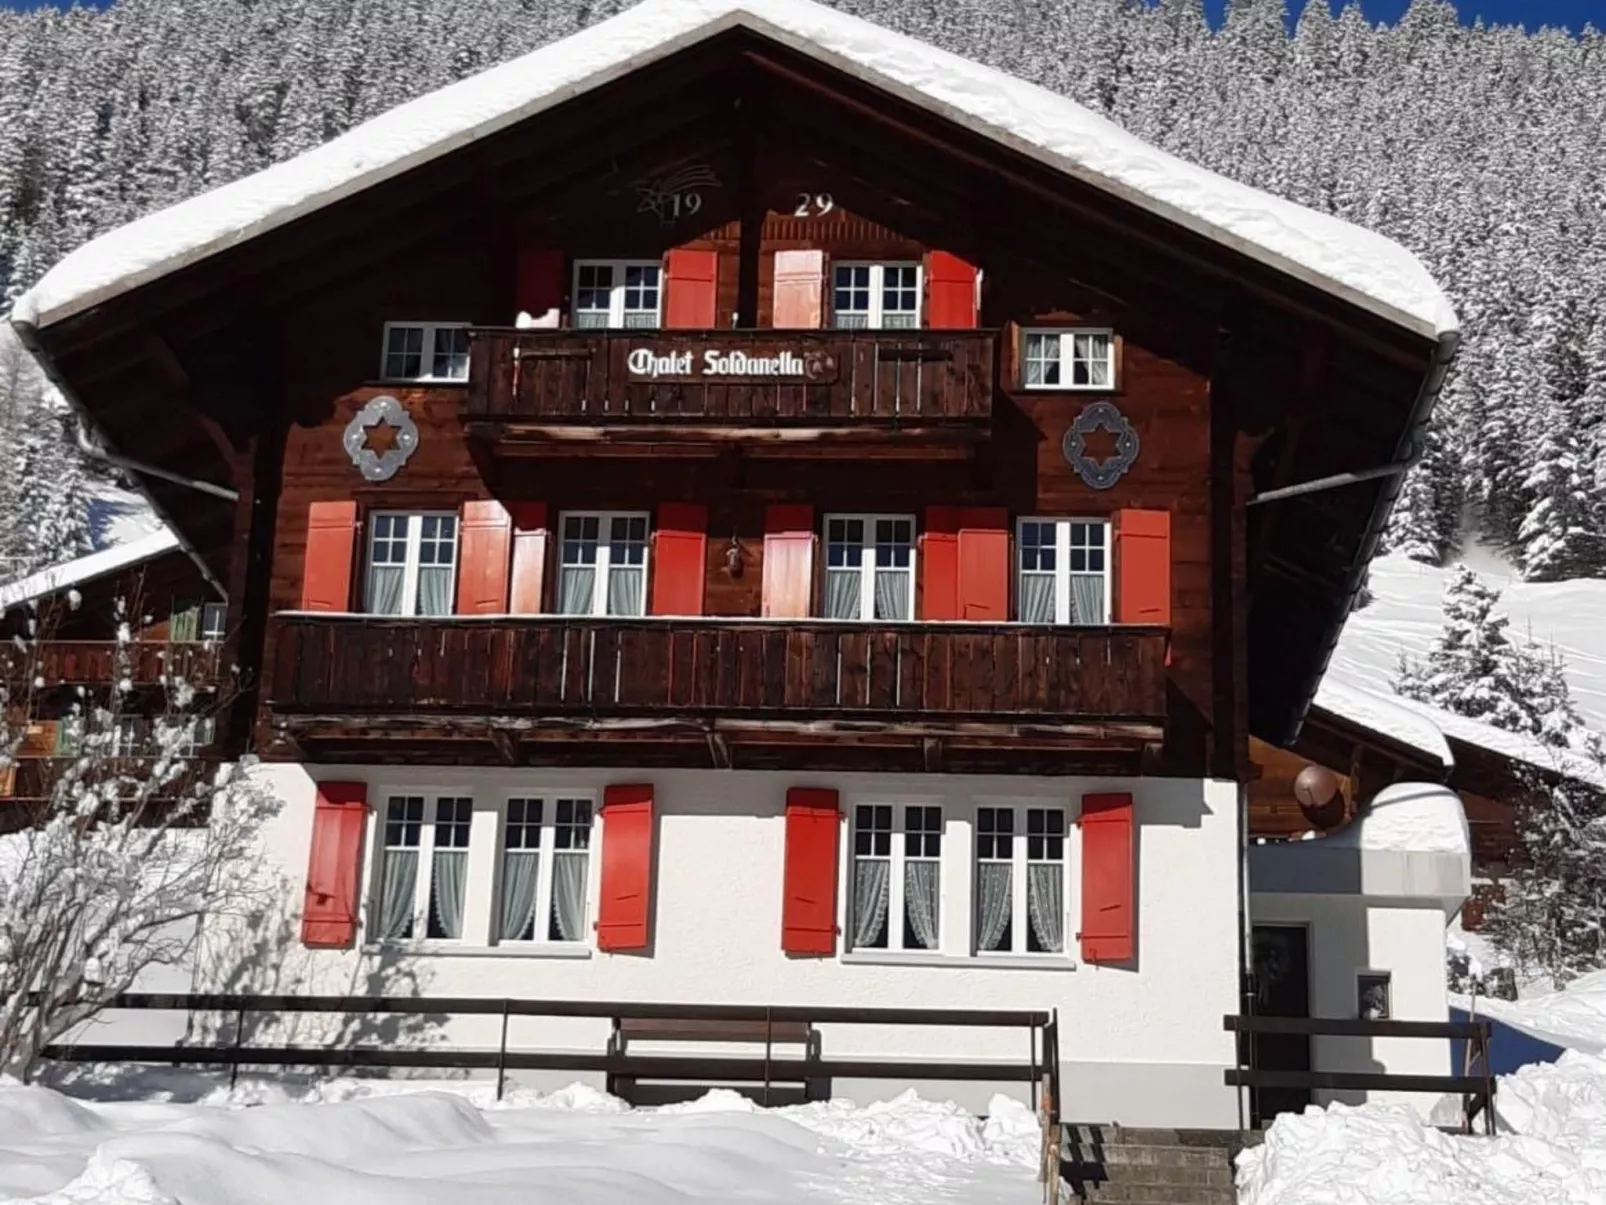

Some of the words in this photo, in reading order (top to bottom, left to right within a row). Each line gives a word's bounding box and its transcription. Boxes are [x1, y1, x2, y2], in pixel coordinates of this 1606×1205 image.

[673, 192, 702, 217] 19
[795, 192, 834, 217] 29
[627, 348, 694, 378] Chalet
[702, 350, 804, 376] Soldanella
